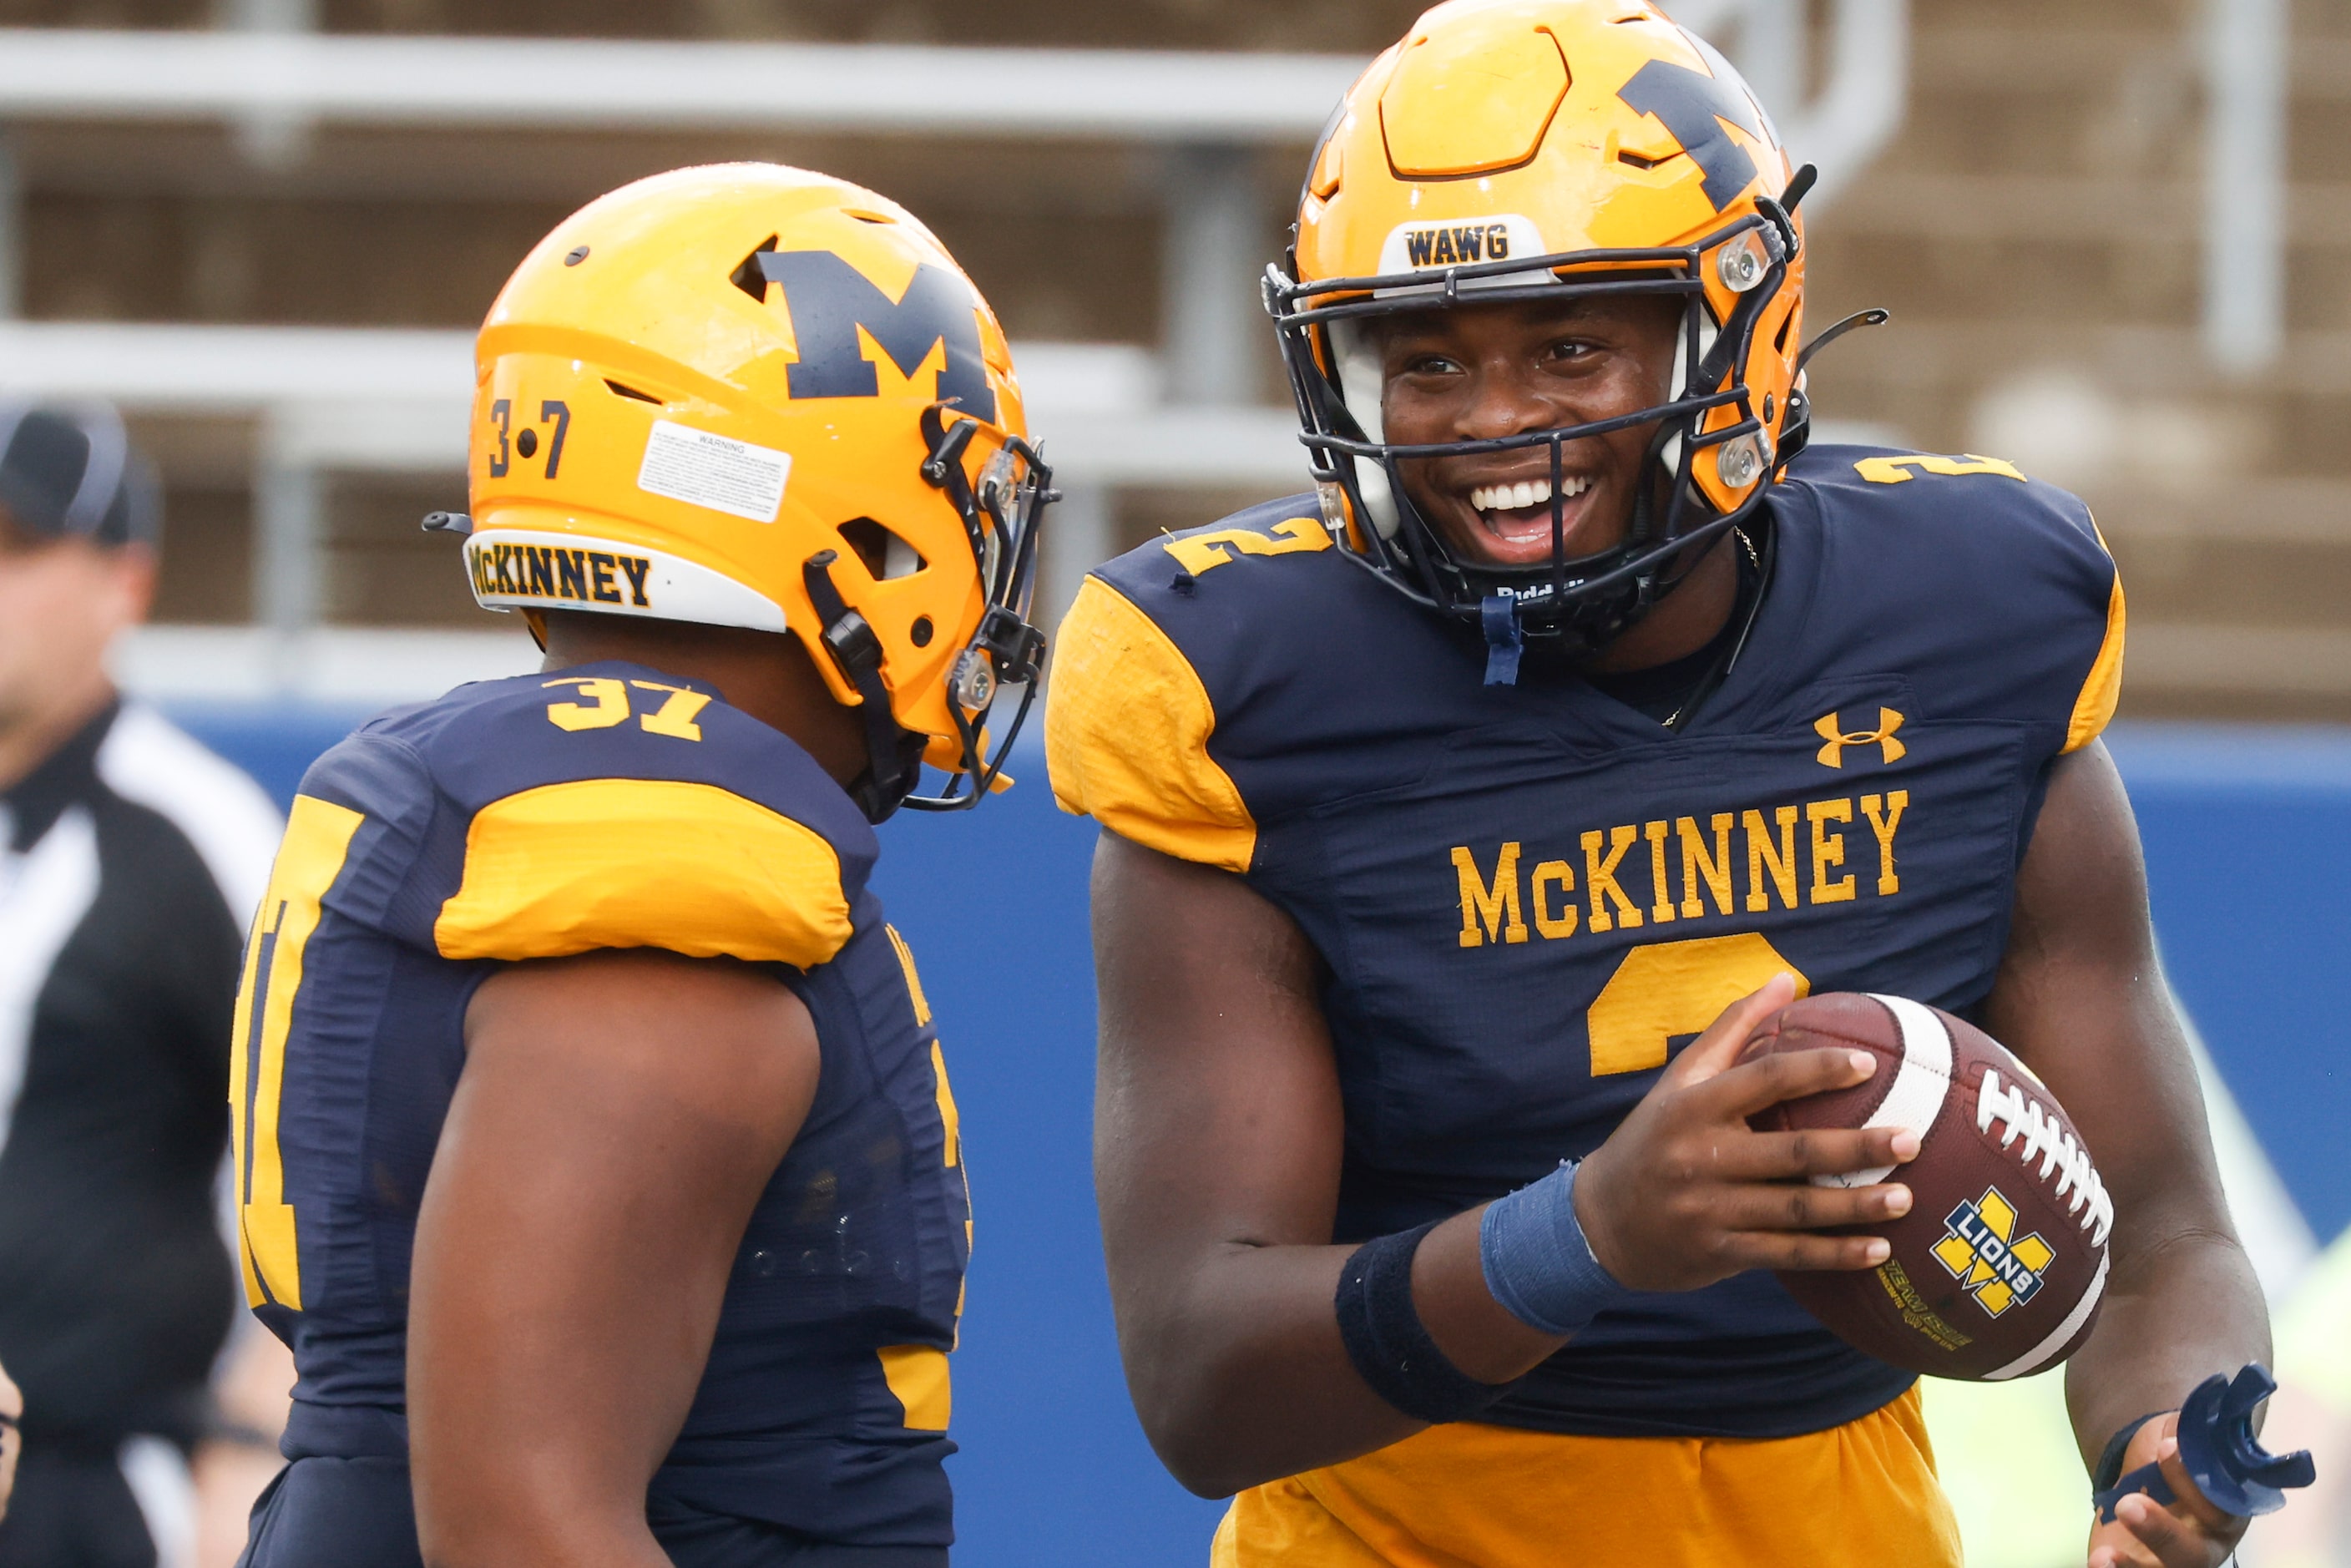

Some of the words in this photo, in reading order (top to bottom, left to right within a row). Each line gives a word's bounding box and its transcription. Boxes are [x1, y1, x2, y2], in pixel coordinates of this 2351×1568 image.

[1404, 224, 1508, 266] WAWG
[756, 250, 997, 426] M
[699, 434, 746, 454] WARNING
[468, 542, 651, 609] McKINNEY
[1162, 518, 1334, 577] 2
[541, 677, 713, 742] 37
[1451, 790, 1909, 947] McKINNEY
[1957, 1211, 2034, 1295] LIONS
[1884, 1259, 1929, 1313] TEAM
